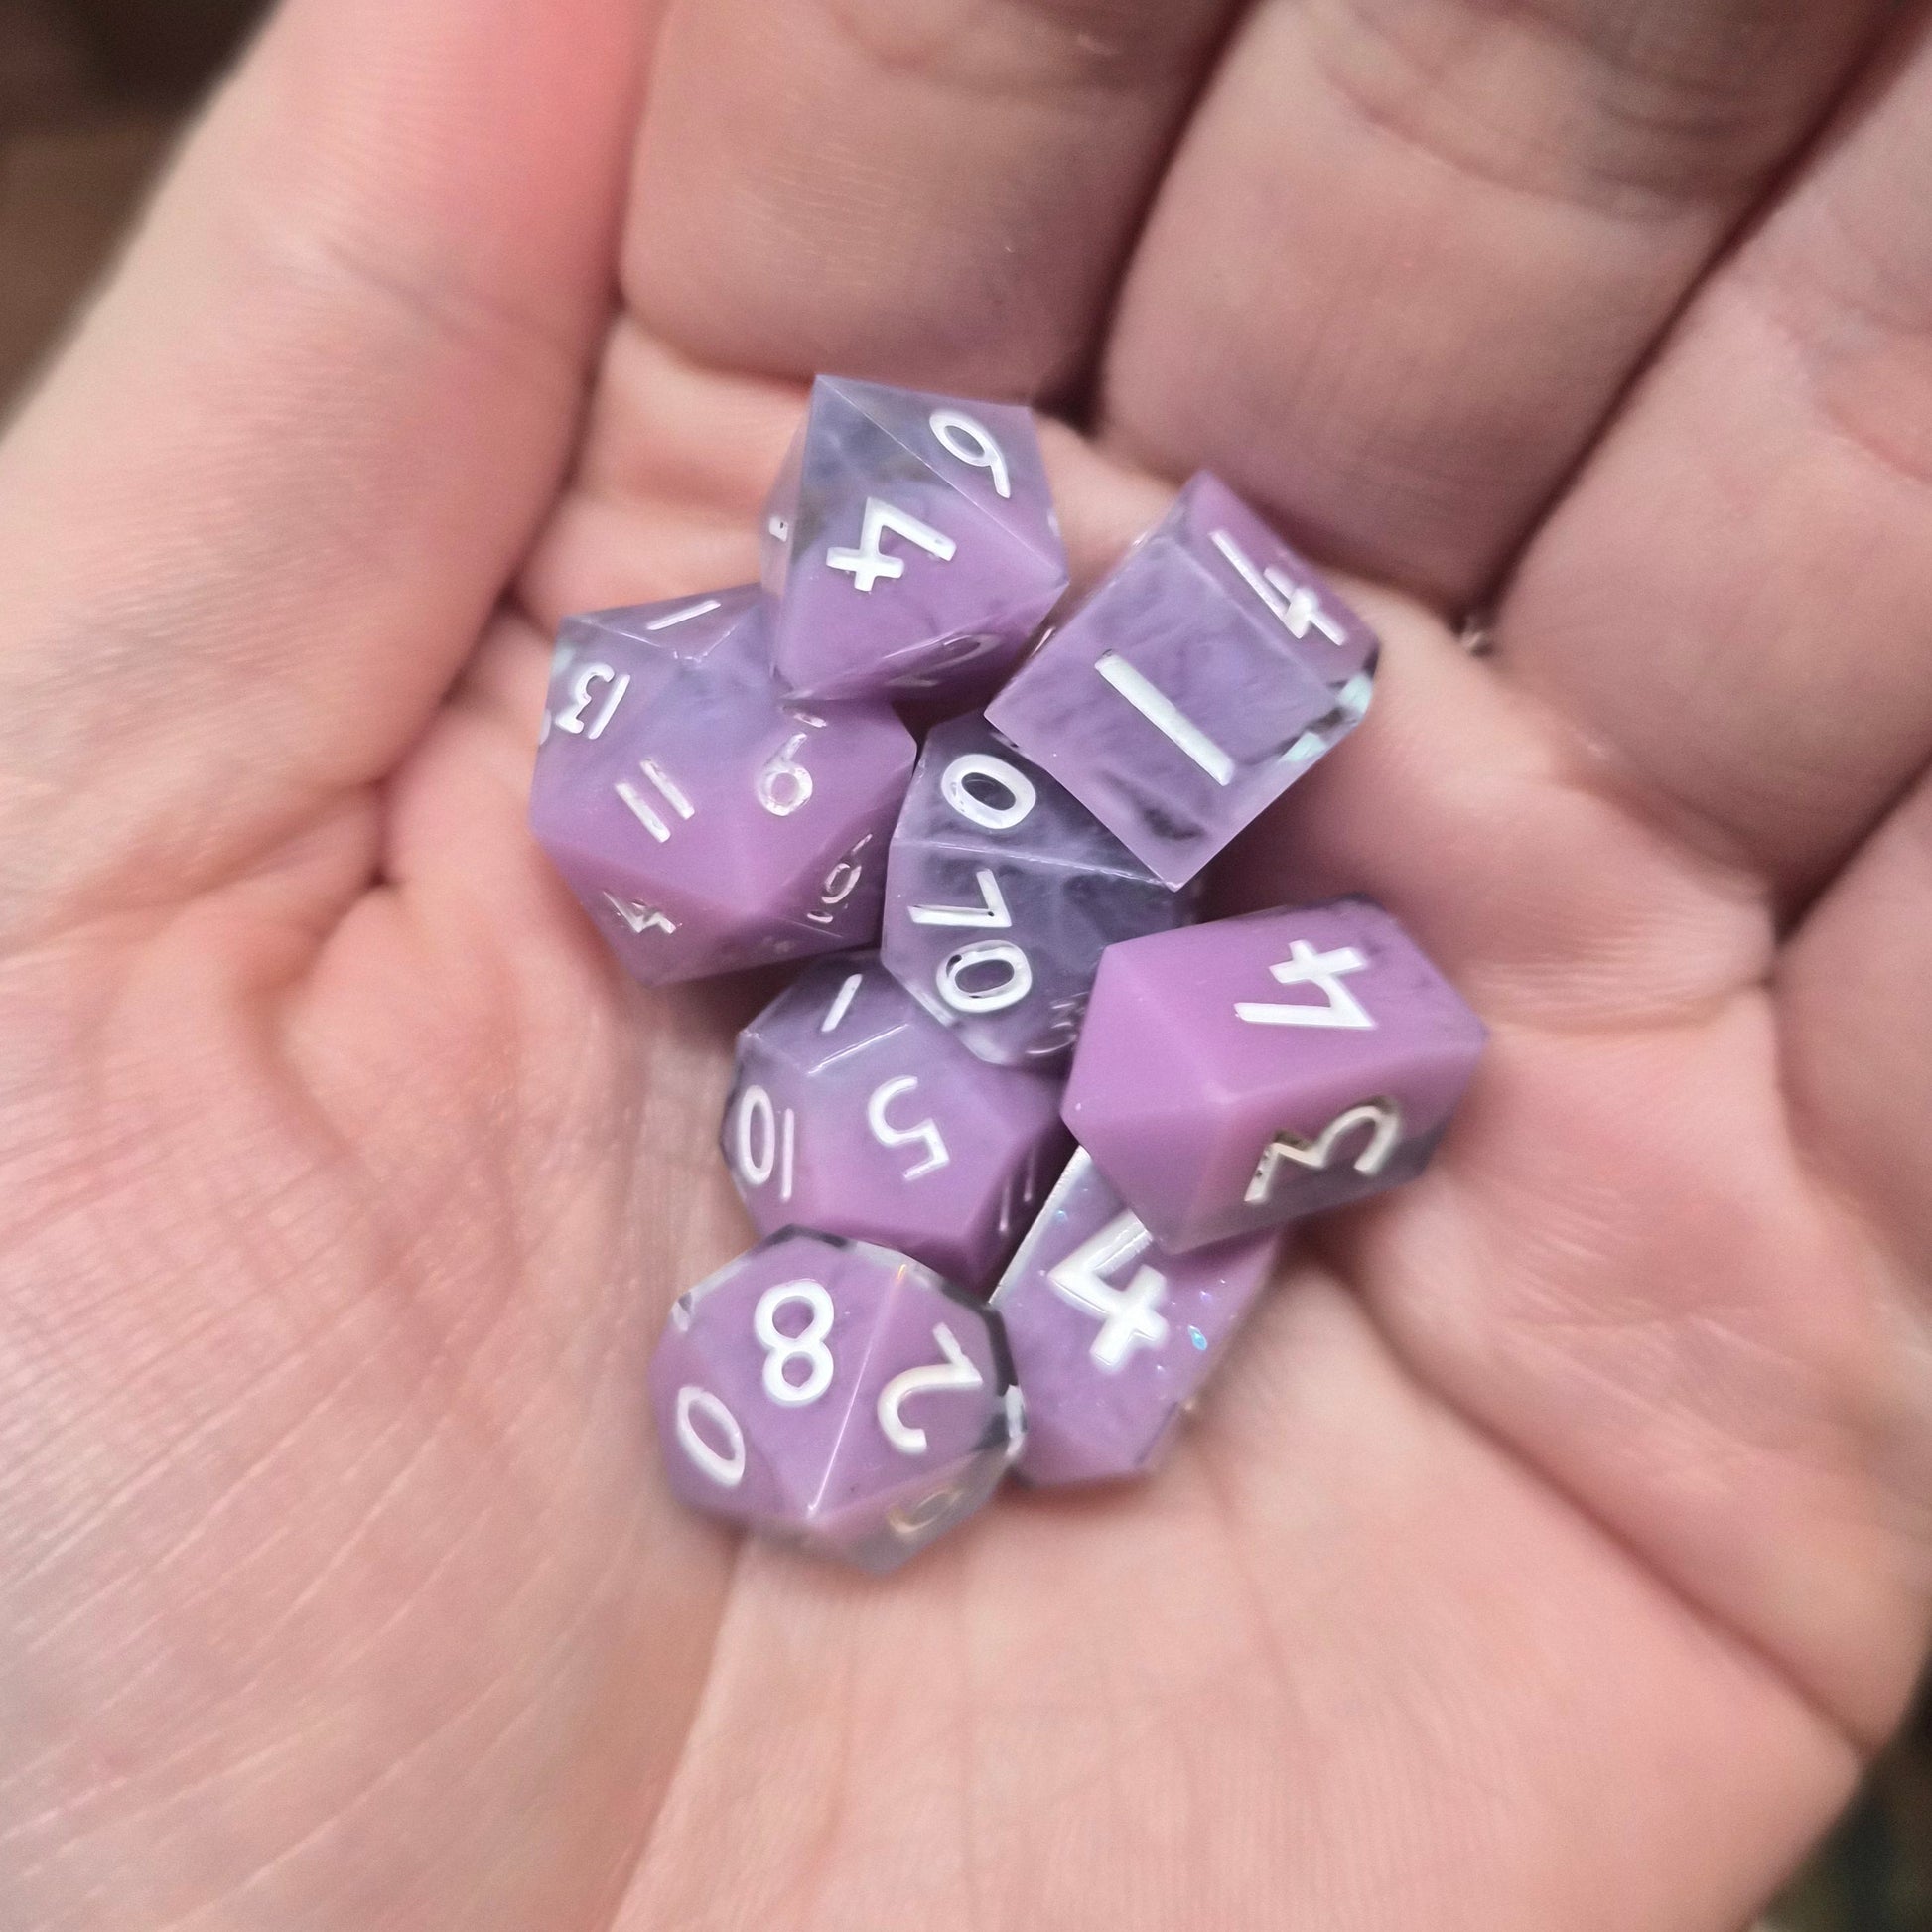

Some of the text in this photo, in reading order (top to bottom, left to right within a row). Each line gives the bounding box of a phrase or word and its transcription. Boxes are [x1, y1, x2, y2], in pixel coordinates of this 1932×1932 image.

[826, 496, 957, 593] 4
[1209, 529, 1348, 645] 4
[646, 599, 722, 631] 1
[554, 662, 631, 740] 13
[1095, 648, 1236, 786] 1
[614, 758, 695, 843] 11
[907, 868, 1033, 1014] 70
[1234, 939, 1378, 1031] 4
[820, 973, 864, 1033] 1
[737, 1085, 795, 1202] 10
[867, 1074, 950, 1181] 5
[1244, 1096, 1404, 1204] 3
[754, 1278, 835, 1408] 8
[1045, 1208, 1170, 1378] 4
[676, 1384, 747, 1487] 0
[877, 1321, 984, 1456] 2
